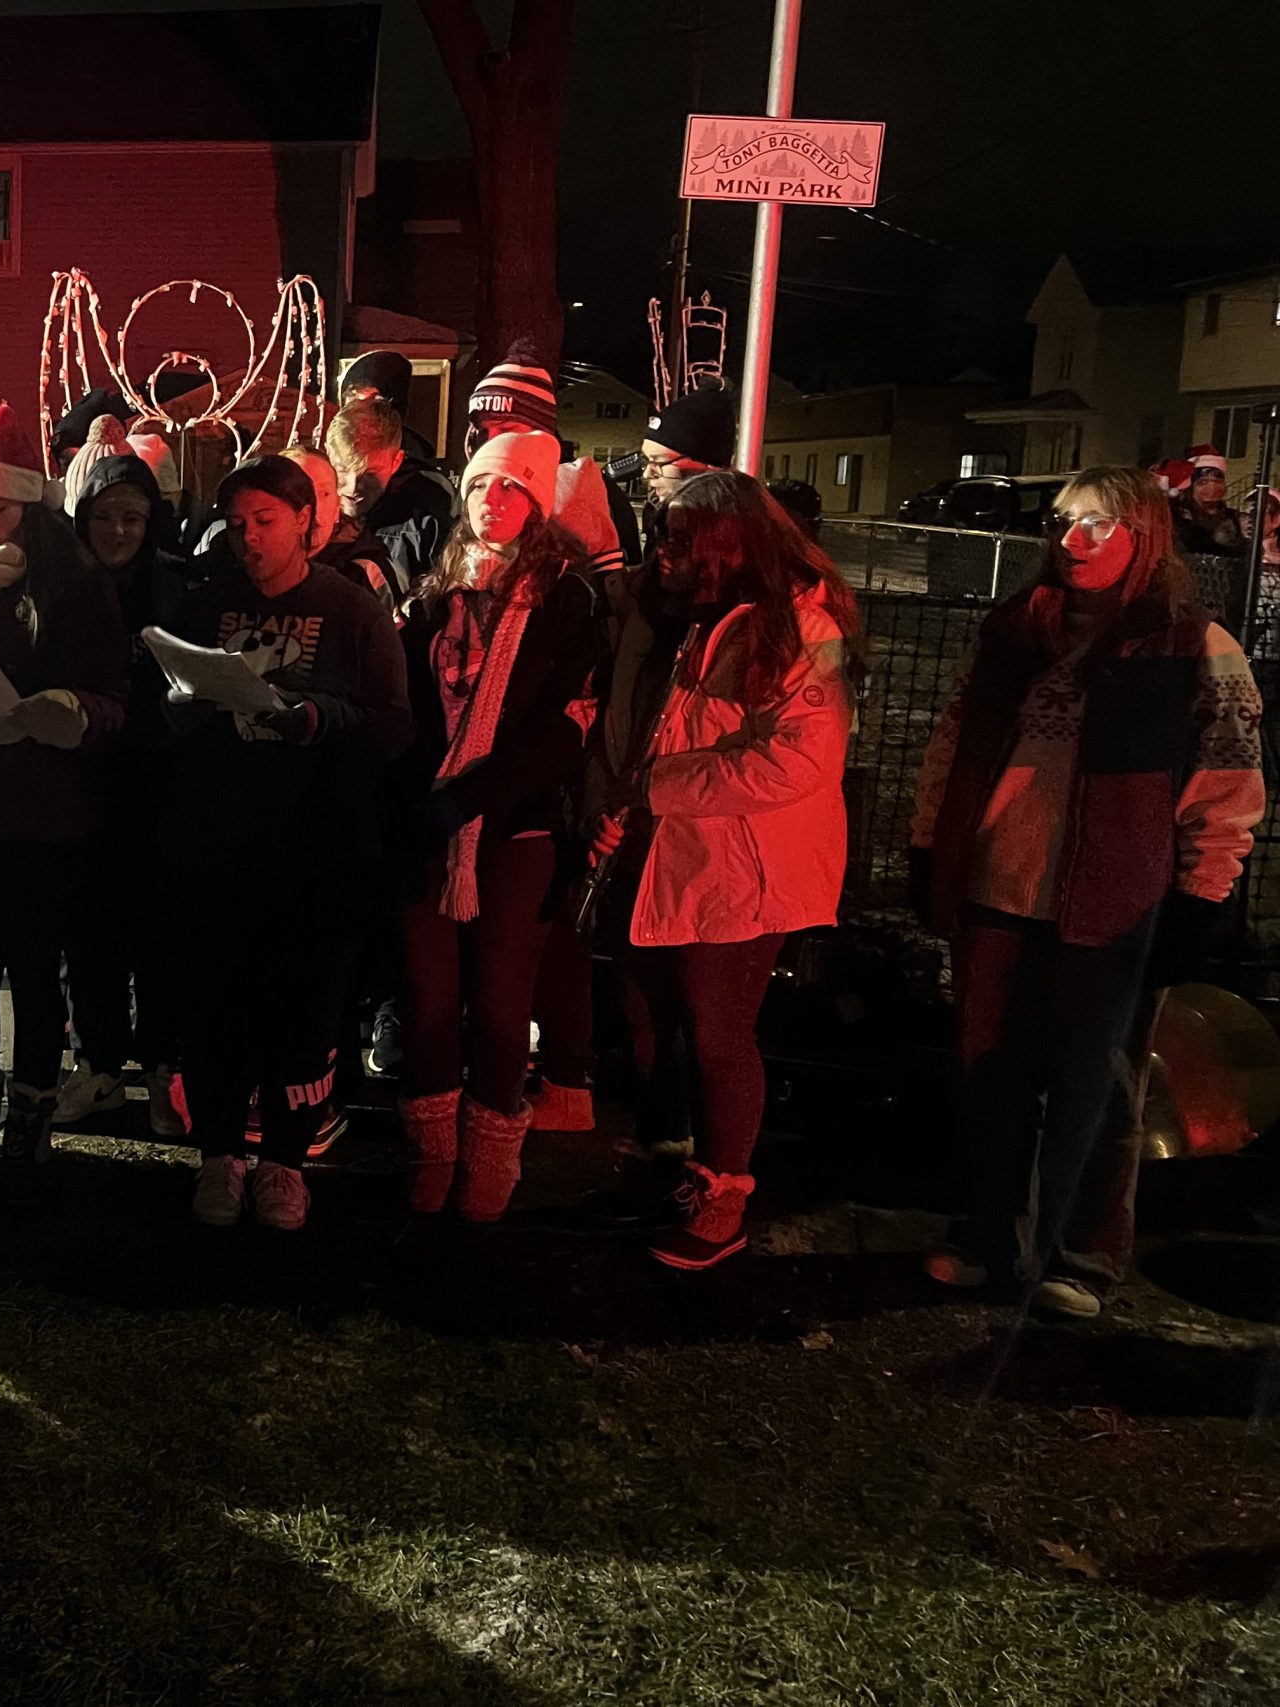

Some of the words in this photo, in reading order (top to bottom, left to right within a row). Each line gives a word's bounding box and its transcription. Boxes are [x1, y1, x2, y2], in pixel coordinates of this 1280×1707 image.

[722, 142, 763, 170] TONY
[768, 135, 840, 177] BAGGETTA
[715, 178, 770, 196] MINI
[778, 182, 843, 199] PARK
[285, 1065, 337, 1111] PUM
